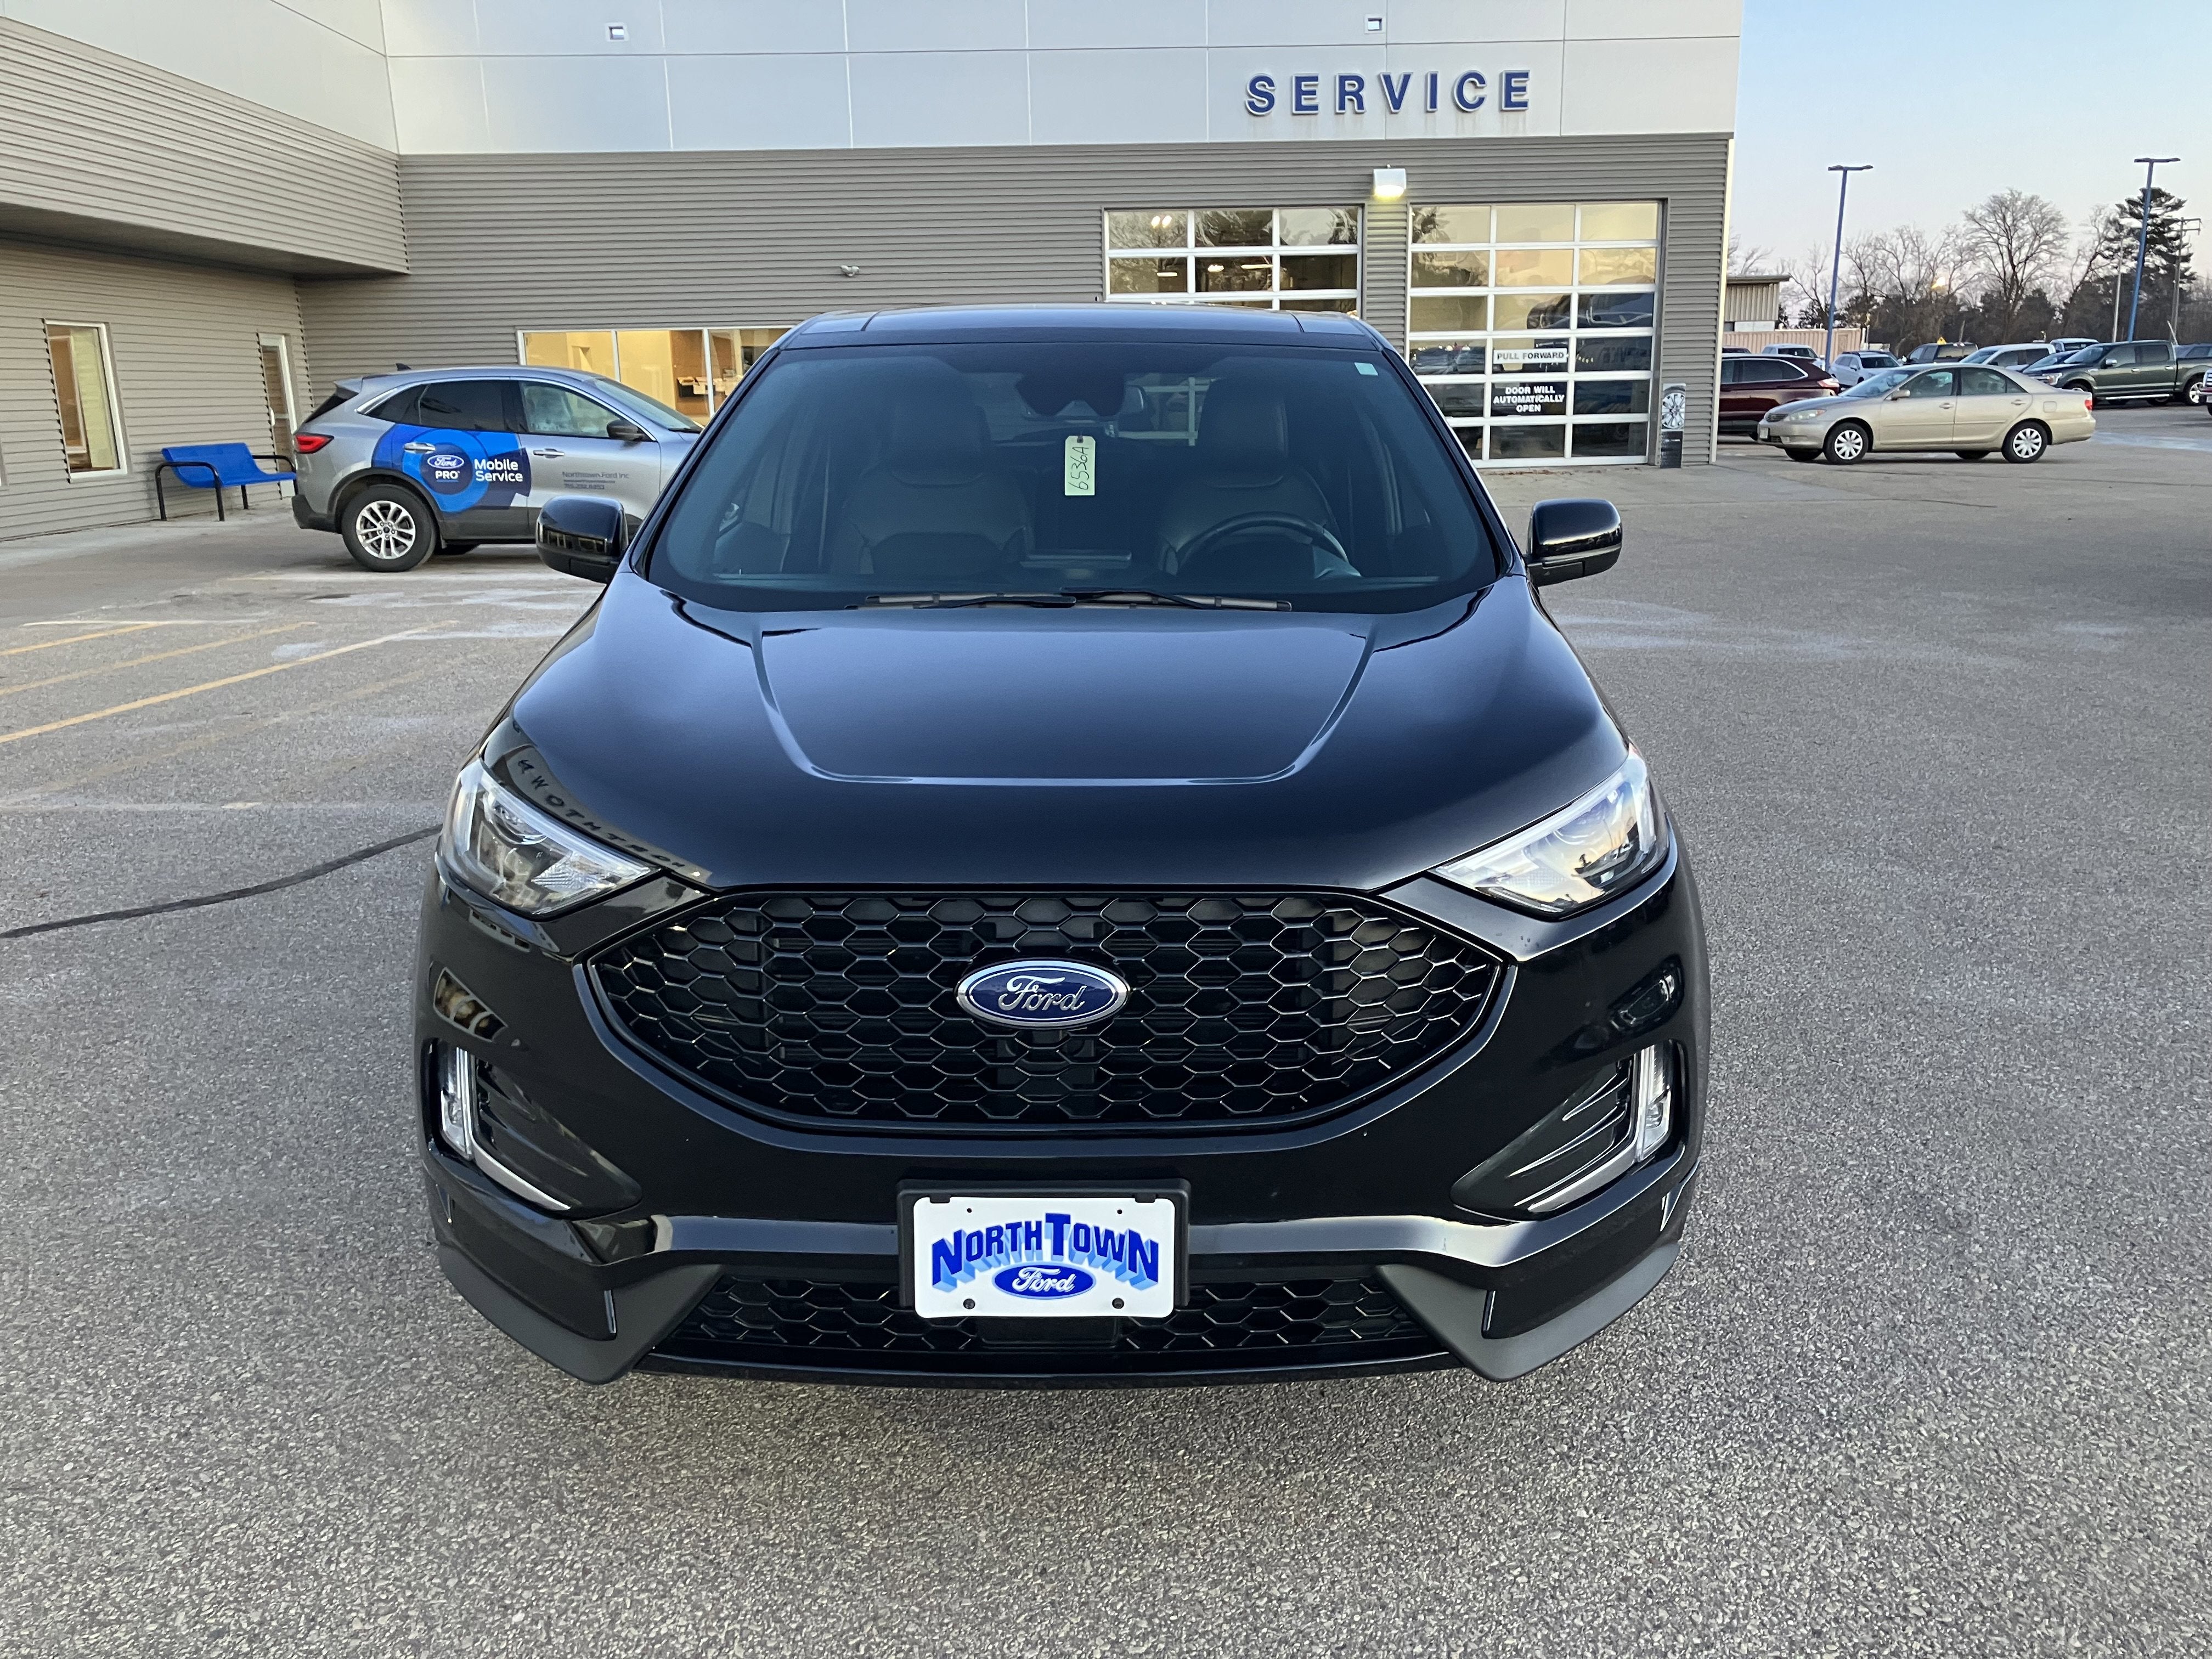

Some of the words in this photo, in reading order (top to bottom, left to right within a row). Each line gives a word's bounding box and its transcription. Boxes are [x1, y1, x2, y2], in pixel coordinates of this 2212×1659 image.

[1245, 69, 1530, 116] SERVICE
[1505, 386, 1531, 394] DOOR
[1533, 385, 1556, 394] WILL
[1493, 394, 1565, 404] AUTOMATICALLY
[1516, 404, 1542, 413] OPEN
[433, 456, 458, 467] Ford
[474, 458, 518, 471] Mobile
[1068, 447, 1090, 490] 6536A
[475, 470, 523, 482] Service
[997, 975, 1088, 1011] Ford
[1012, 1266, 1076, 1293] Ford
